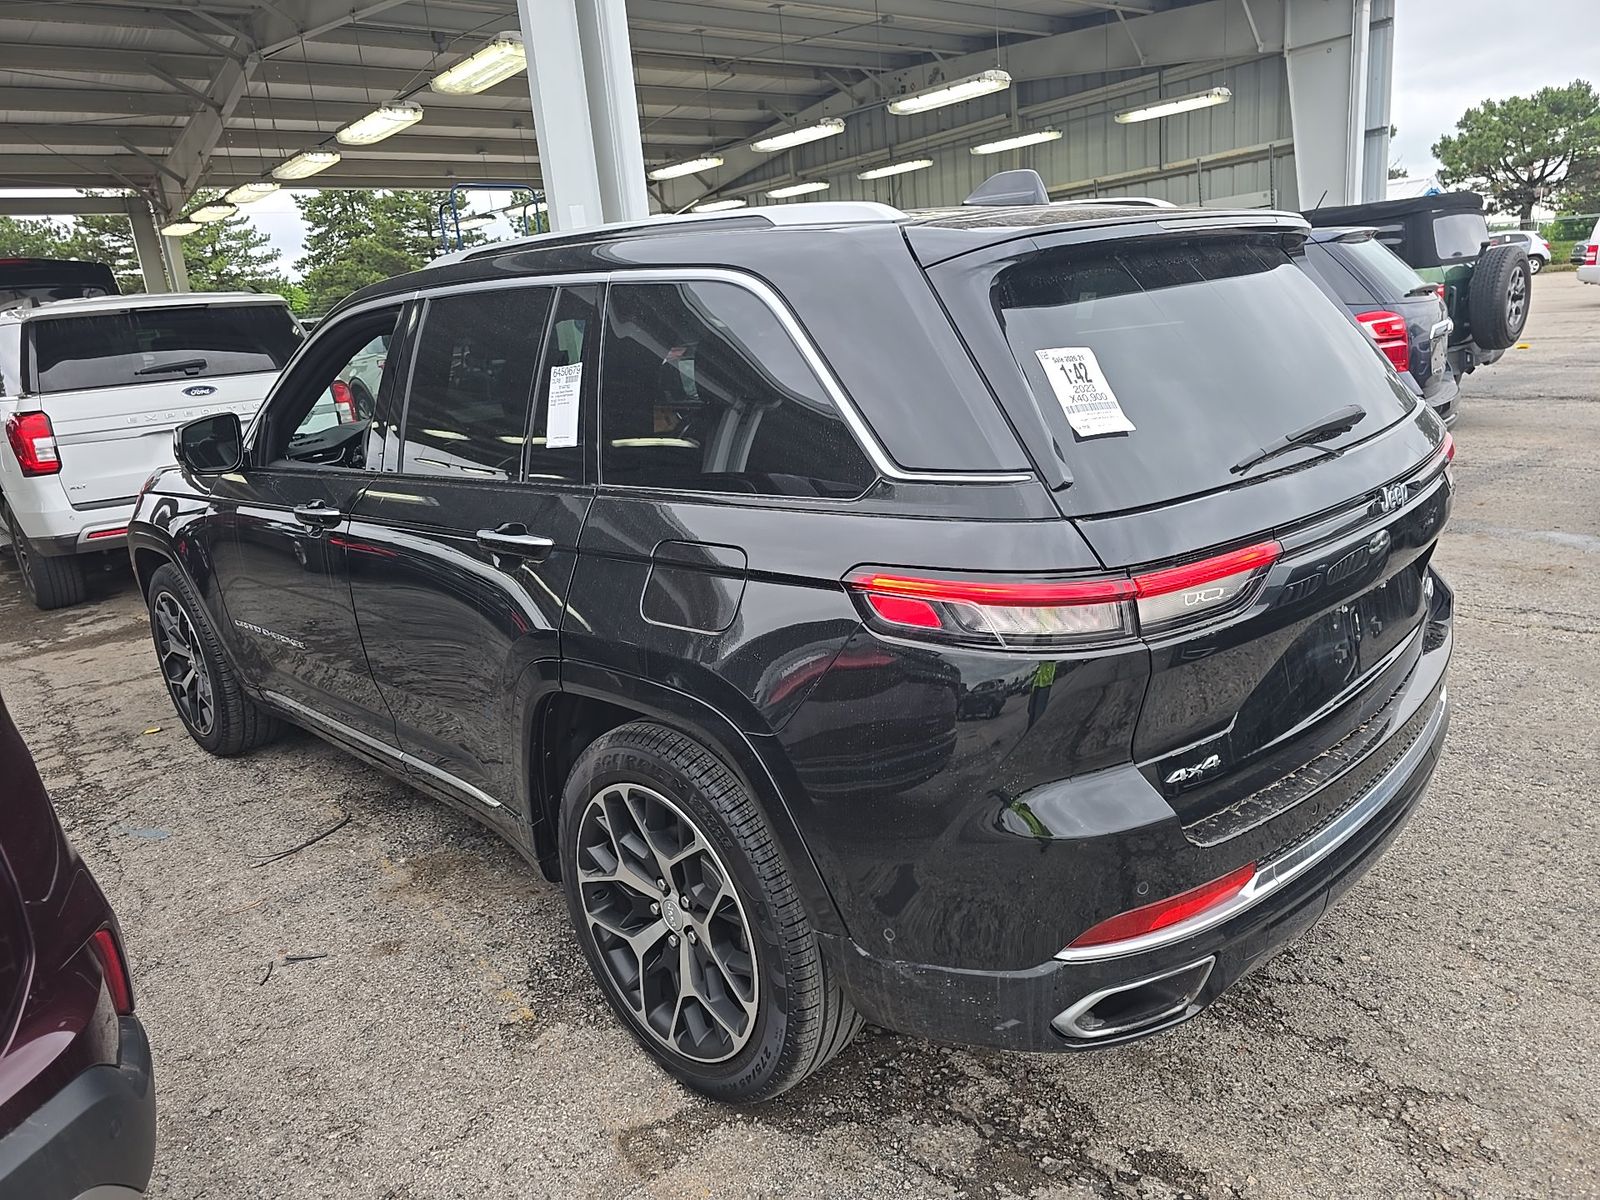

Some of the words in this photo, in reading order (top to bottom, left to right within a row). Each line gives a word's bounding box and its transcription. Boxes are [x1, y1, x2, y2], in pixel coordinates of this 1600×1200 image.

[553, 364, 581, 378] 6450679
[1059, 362, 1093, 385] 1:42
[1072, 384, 1097, 394] 2023
[126, 401, 262, 425] EXPEDITIO
[1381, 482, 1408, 513] Jeep
